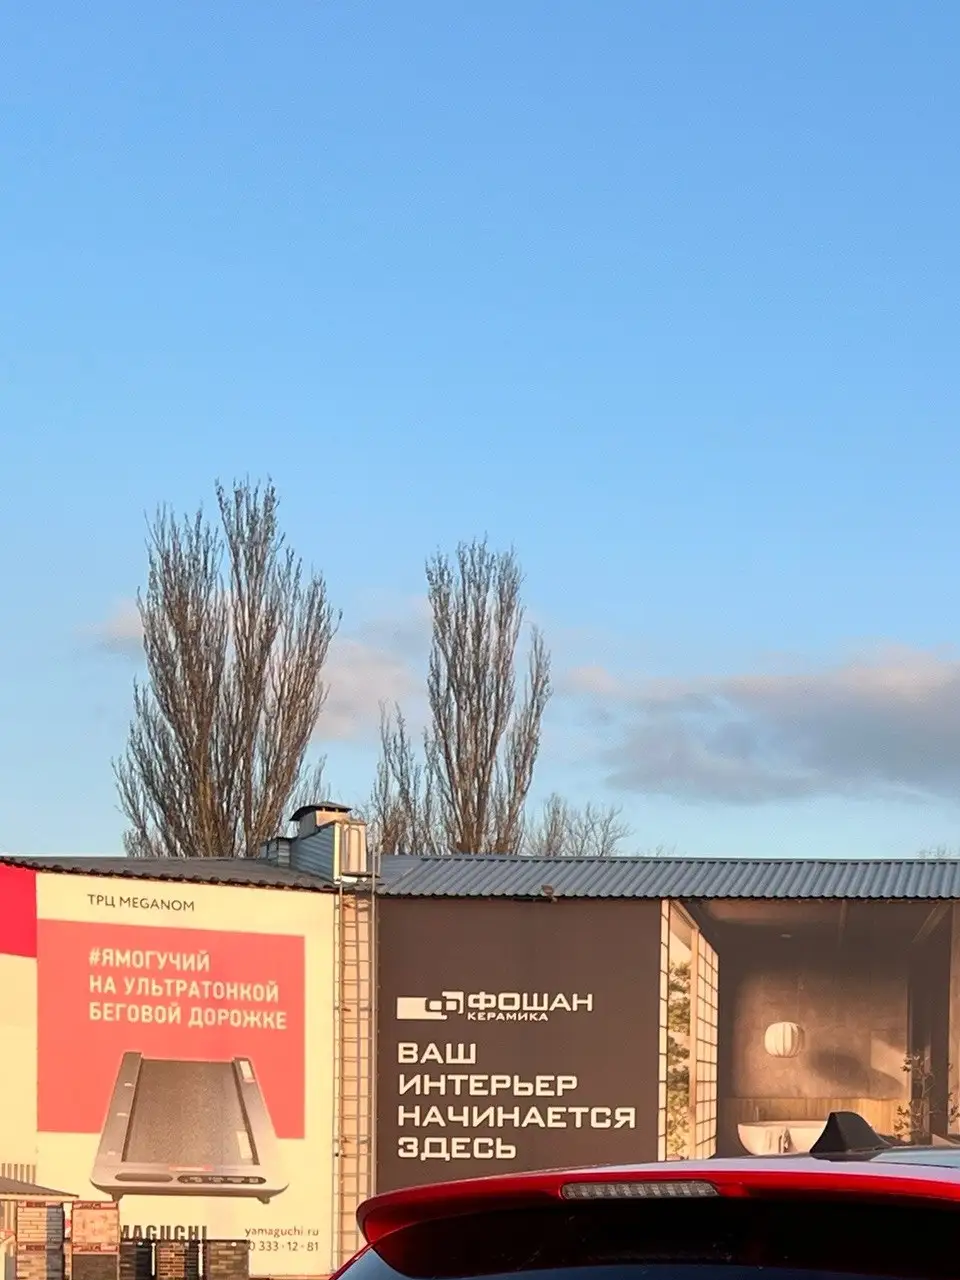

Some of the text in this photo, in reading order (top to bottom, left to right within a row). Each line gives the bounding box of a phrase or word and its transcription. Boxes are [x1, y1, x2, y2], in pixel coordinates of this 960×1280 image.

[87, 894, 195, 911] ТРЦ MEGANOM
[89, 948, 210, 972] #ЯМОГУЧИЙ
[89, 974, 279, 1003] НА УЛЬТРАТОНКОЙ
[467, 991, 593, 1012] ФОШАН
[89, 1001, 287, 1030] БЕГОВОЙ ДОРОЖКЕ
[467, 1012, 549, 1021] КЕРАМИКА
[398, 1042, 477, 1064] ВАШ
[398, 1074, 578, 1097] ИНТЕРЬЕР
[398, 1105, 636, 1129] НАЧИНАЕТСЯ
[398, 1137, 517, 1161] ЗДЕСЬ
